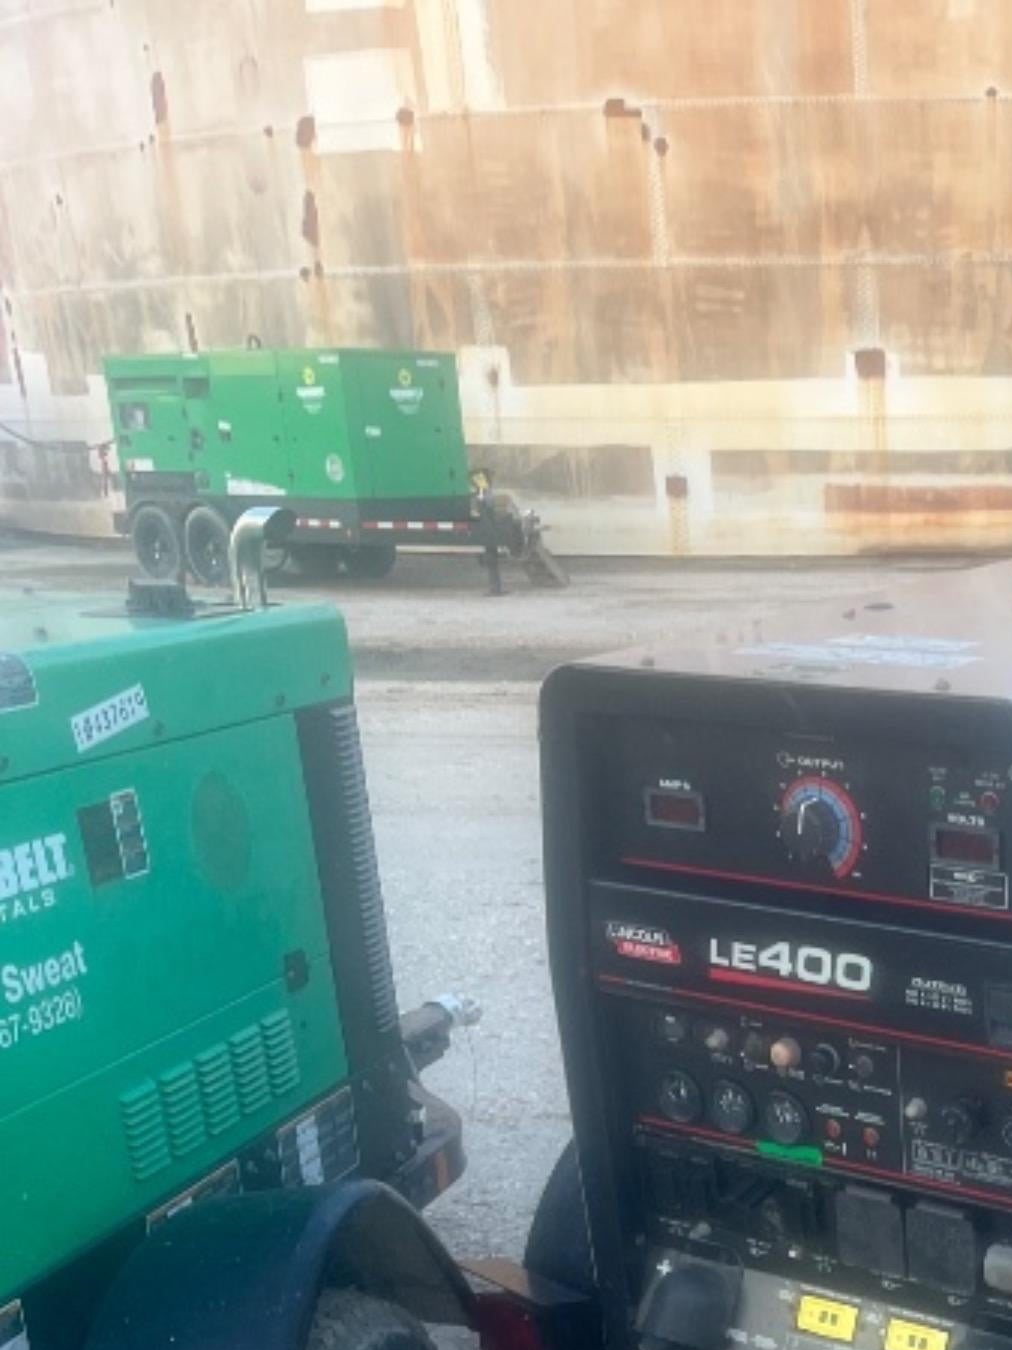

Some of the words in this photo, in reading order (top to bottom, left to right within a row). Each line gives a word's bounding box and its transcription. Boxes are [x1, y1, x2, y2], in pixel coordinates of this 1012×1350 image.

[0, 832, 68, 899] BELT
[2, 940, 88, 1003] Sweat
[709, 938, 872, 991] LE400
